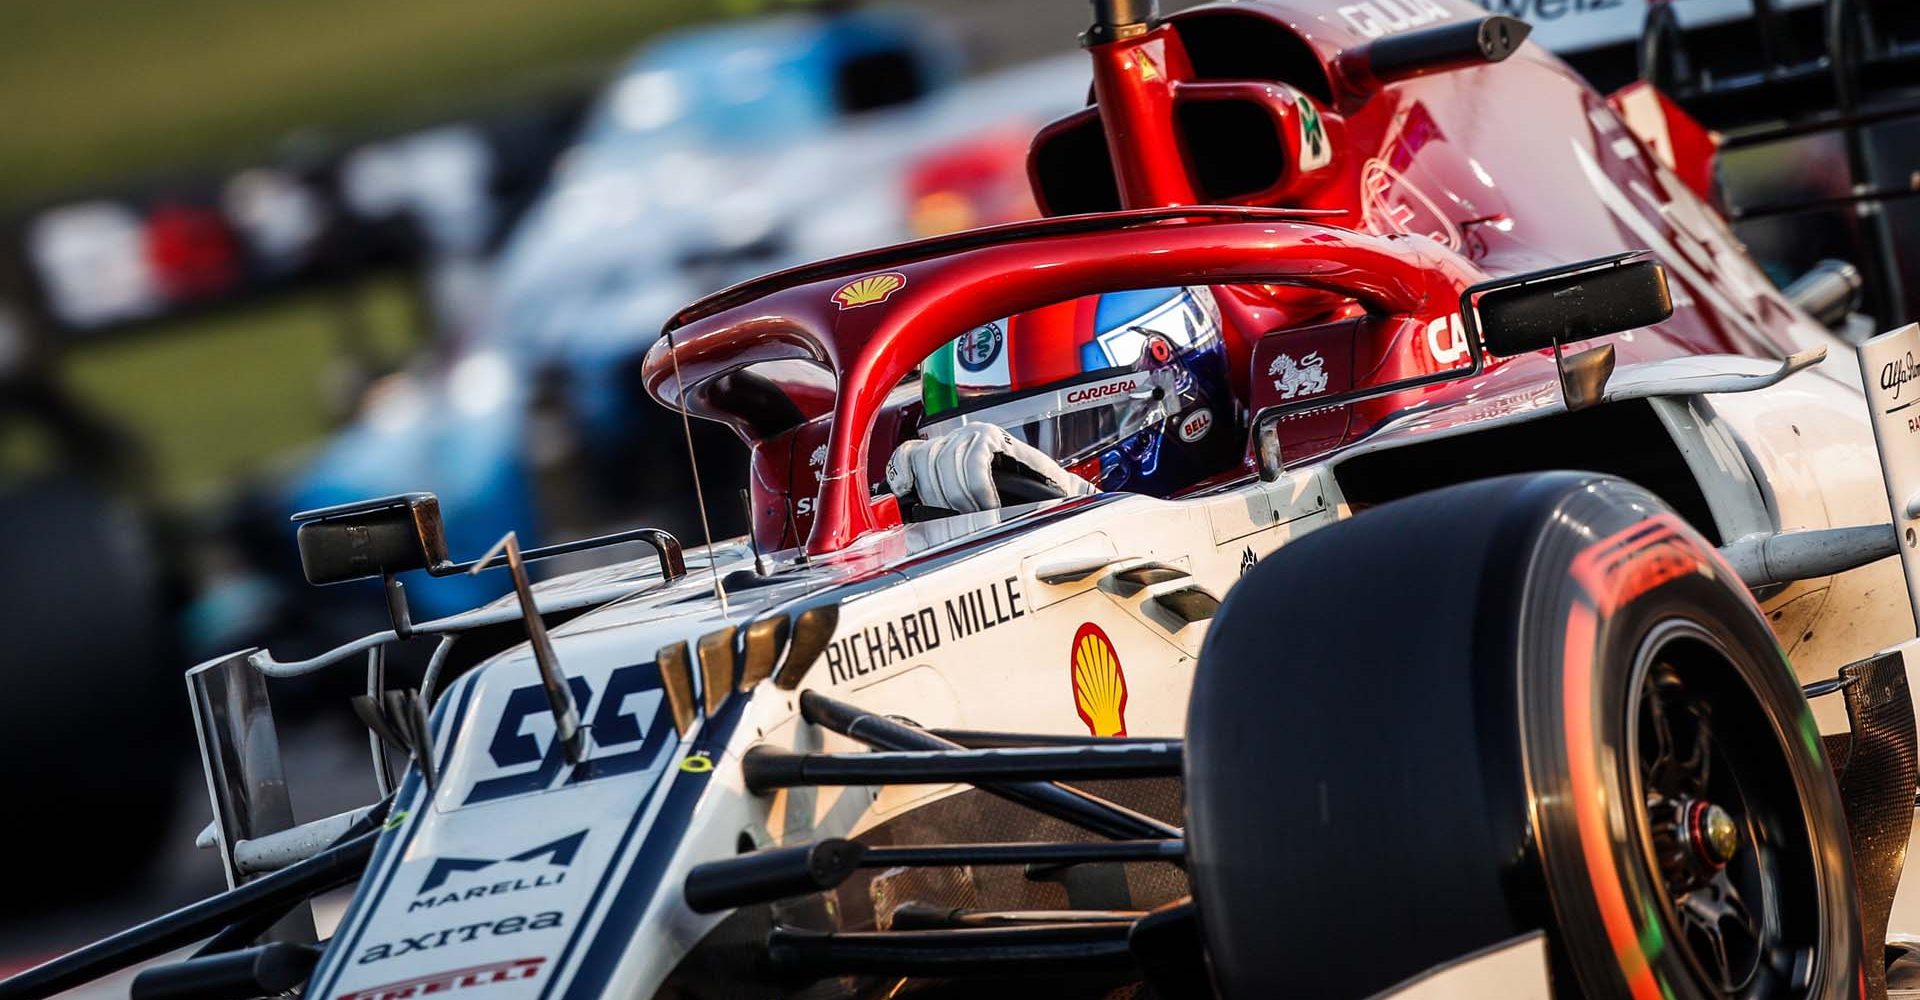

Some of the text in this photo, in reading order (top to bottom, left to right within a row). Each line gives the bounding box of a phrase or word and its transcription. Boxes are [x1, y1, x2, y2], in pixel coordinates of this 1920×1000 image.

[1067, 379, 1137, 403] CARRERA
[1184, 414, 1210, 437] BELL
[826, 576, 1025, 685] RICHARD MILLE
[462, 661, 677, 806] 99
[407, 872, 566, 913] MARELLI
